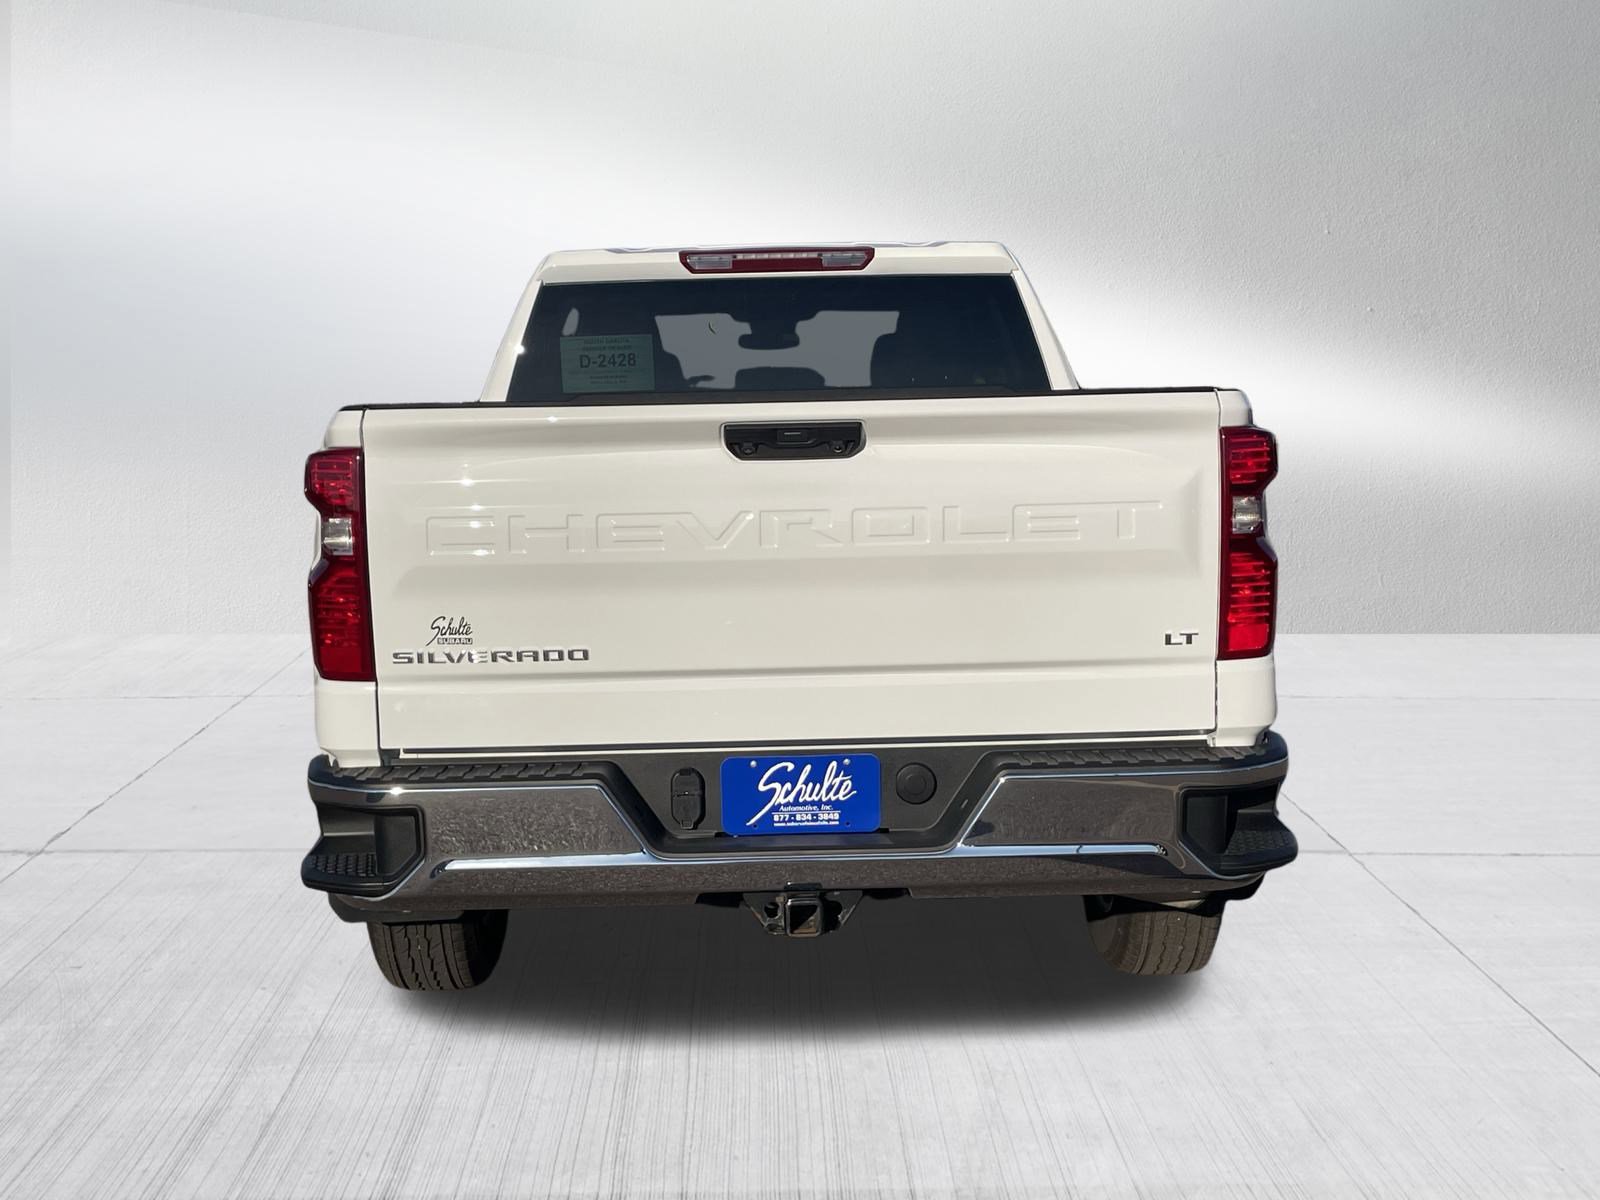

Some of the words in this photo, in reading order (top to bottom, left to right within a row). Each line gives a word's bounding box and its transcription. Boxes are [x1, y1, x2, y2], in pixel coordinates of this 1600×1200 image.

[579, 352, 637, 369] D-2428
[425, 500, 1164, 555] CHEVROLET
[425, 615, 474, 646] Schulte
[1165, 632, 1199, 646] LT
[437, 637, 474, 645] SUBARU
[392, 648, 590, 665] SILVERADO
[745, 760, 857, 826] Schulte
